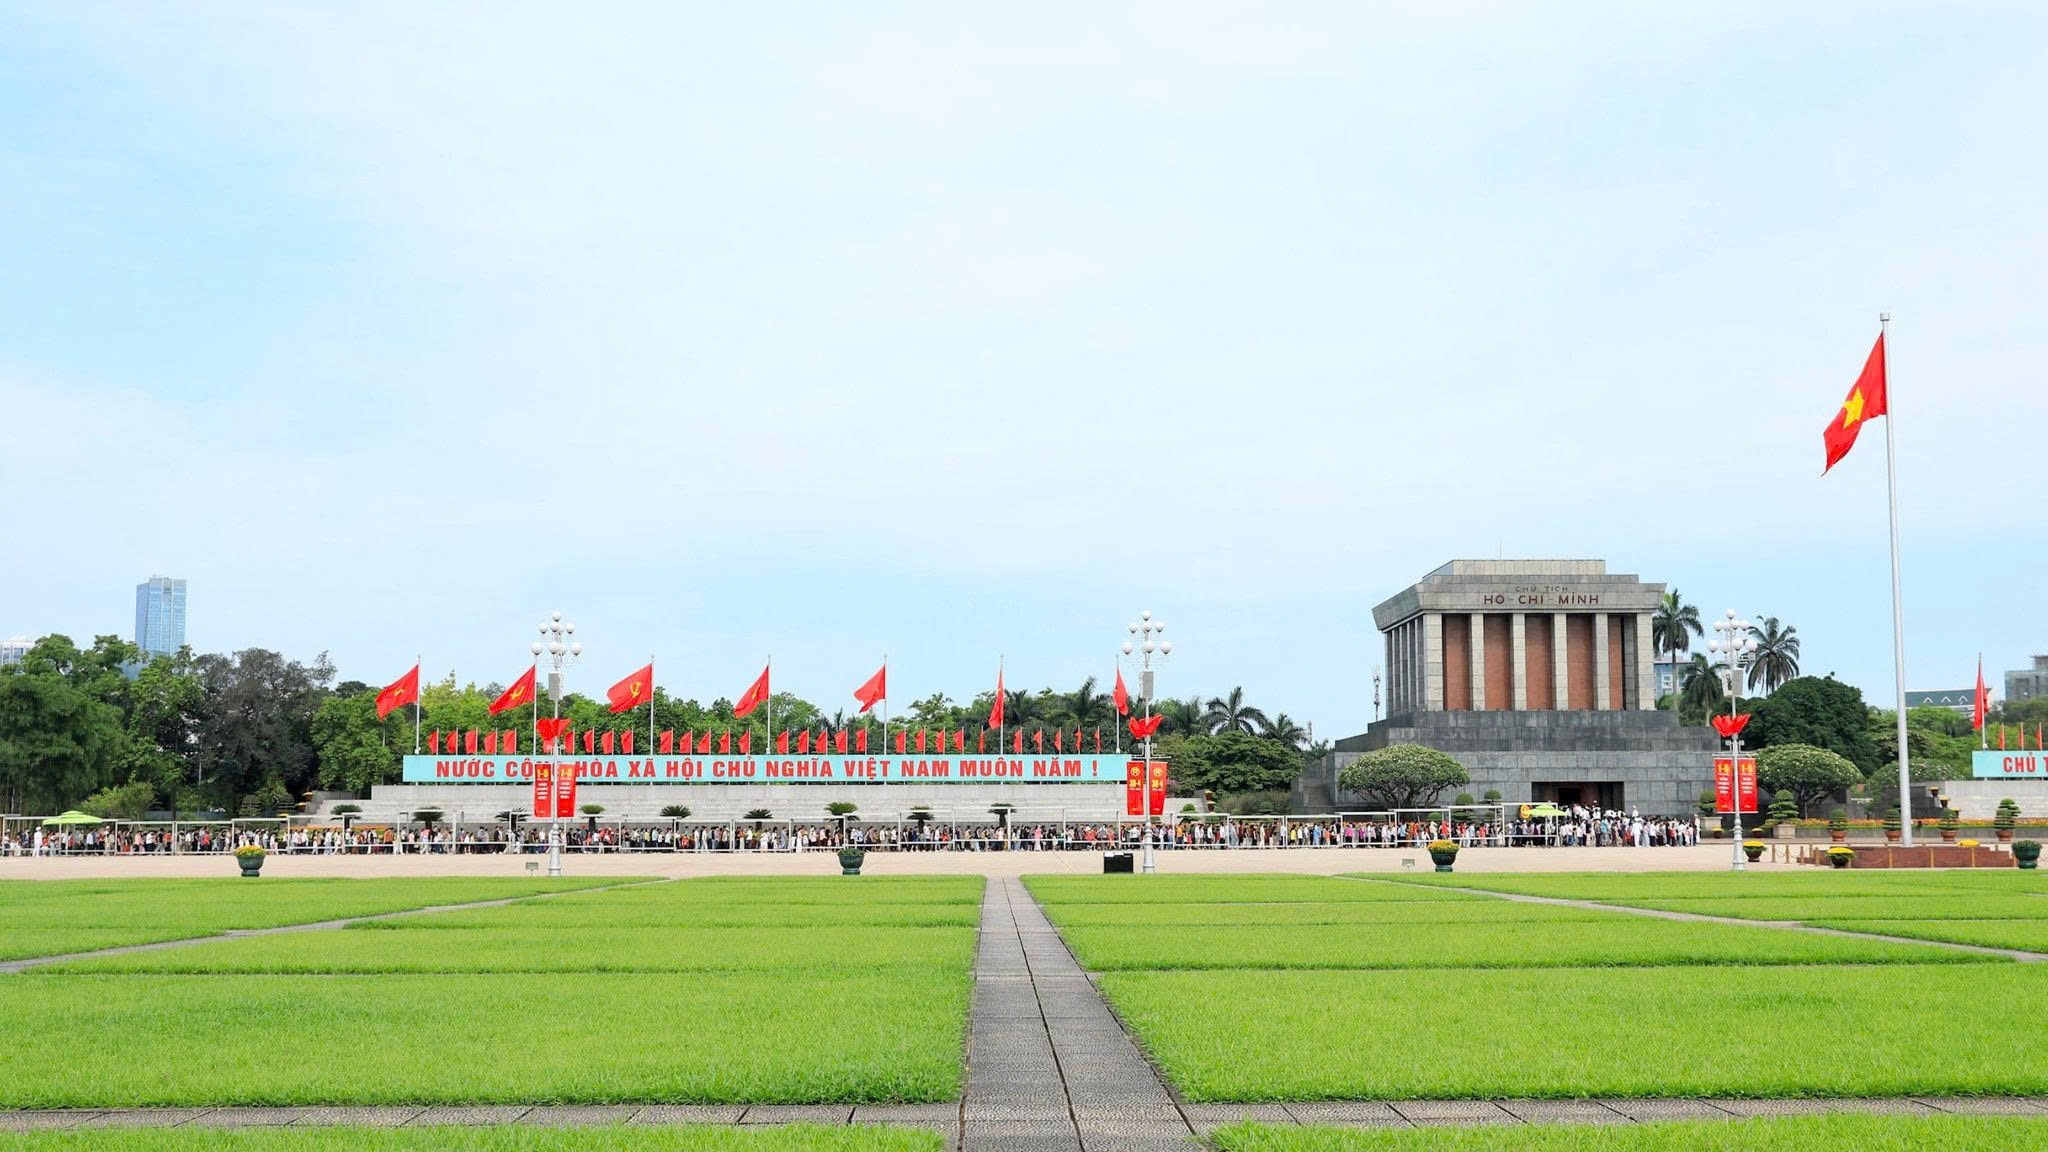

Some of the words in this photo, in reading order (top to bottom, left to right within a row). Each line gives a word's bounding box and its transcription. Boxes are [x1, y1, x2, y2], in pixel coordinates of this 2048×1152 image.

[436, 758, 496, 778] NƯỚC
[575, 758, 618, 778] HÒA
[628, 758, 656, 777] XÃ
[665, 757, 703, 780] HỘI
[712, 755, 756, 777] CHỦ
[765, 757, 833, 777] NGHĨA
[844, 757, 890, 779] VIỆT
[900, 760, 950, 777] NAM
[959, 757, 1024, 777] MUÔN
[1033, 757, 1082, 777] NĂM
[2003, 752, 2036, 773] CHỦ
